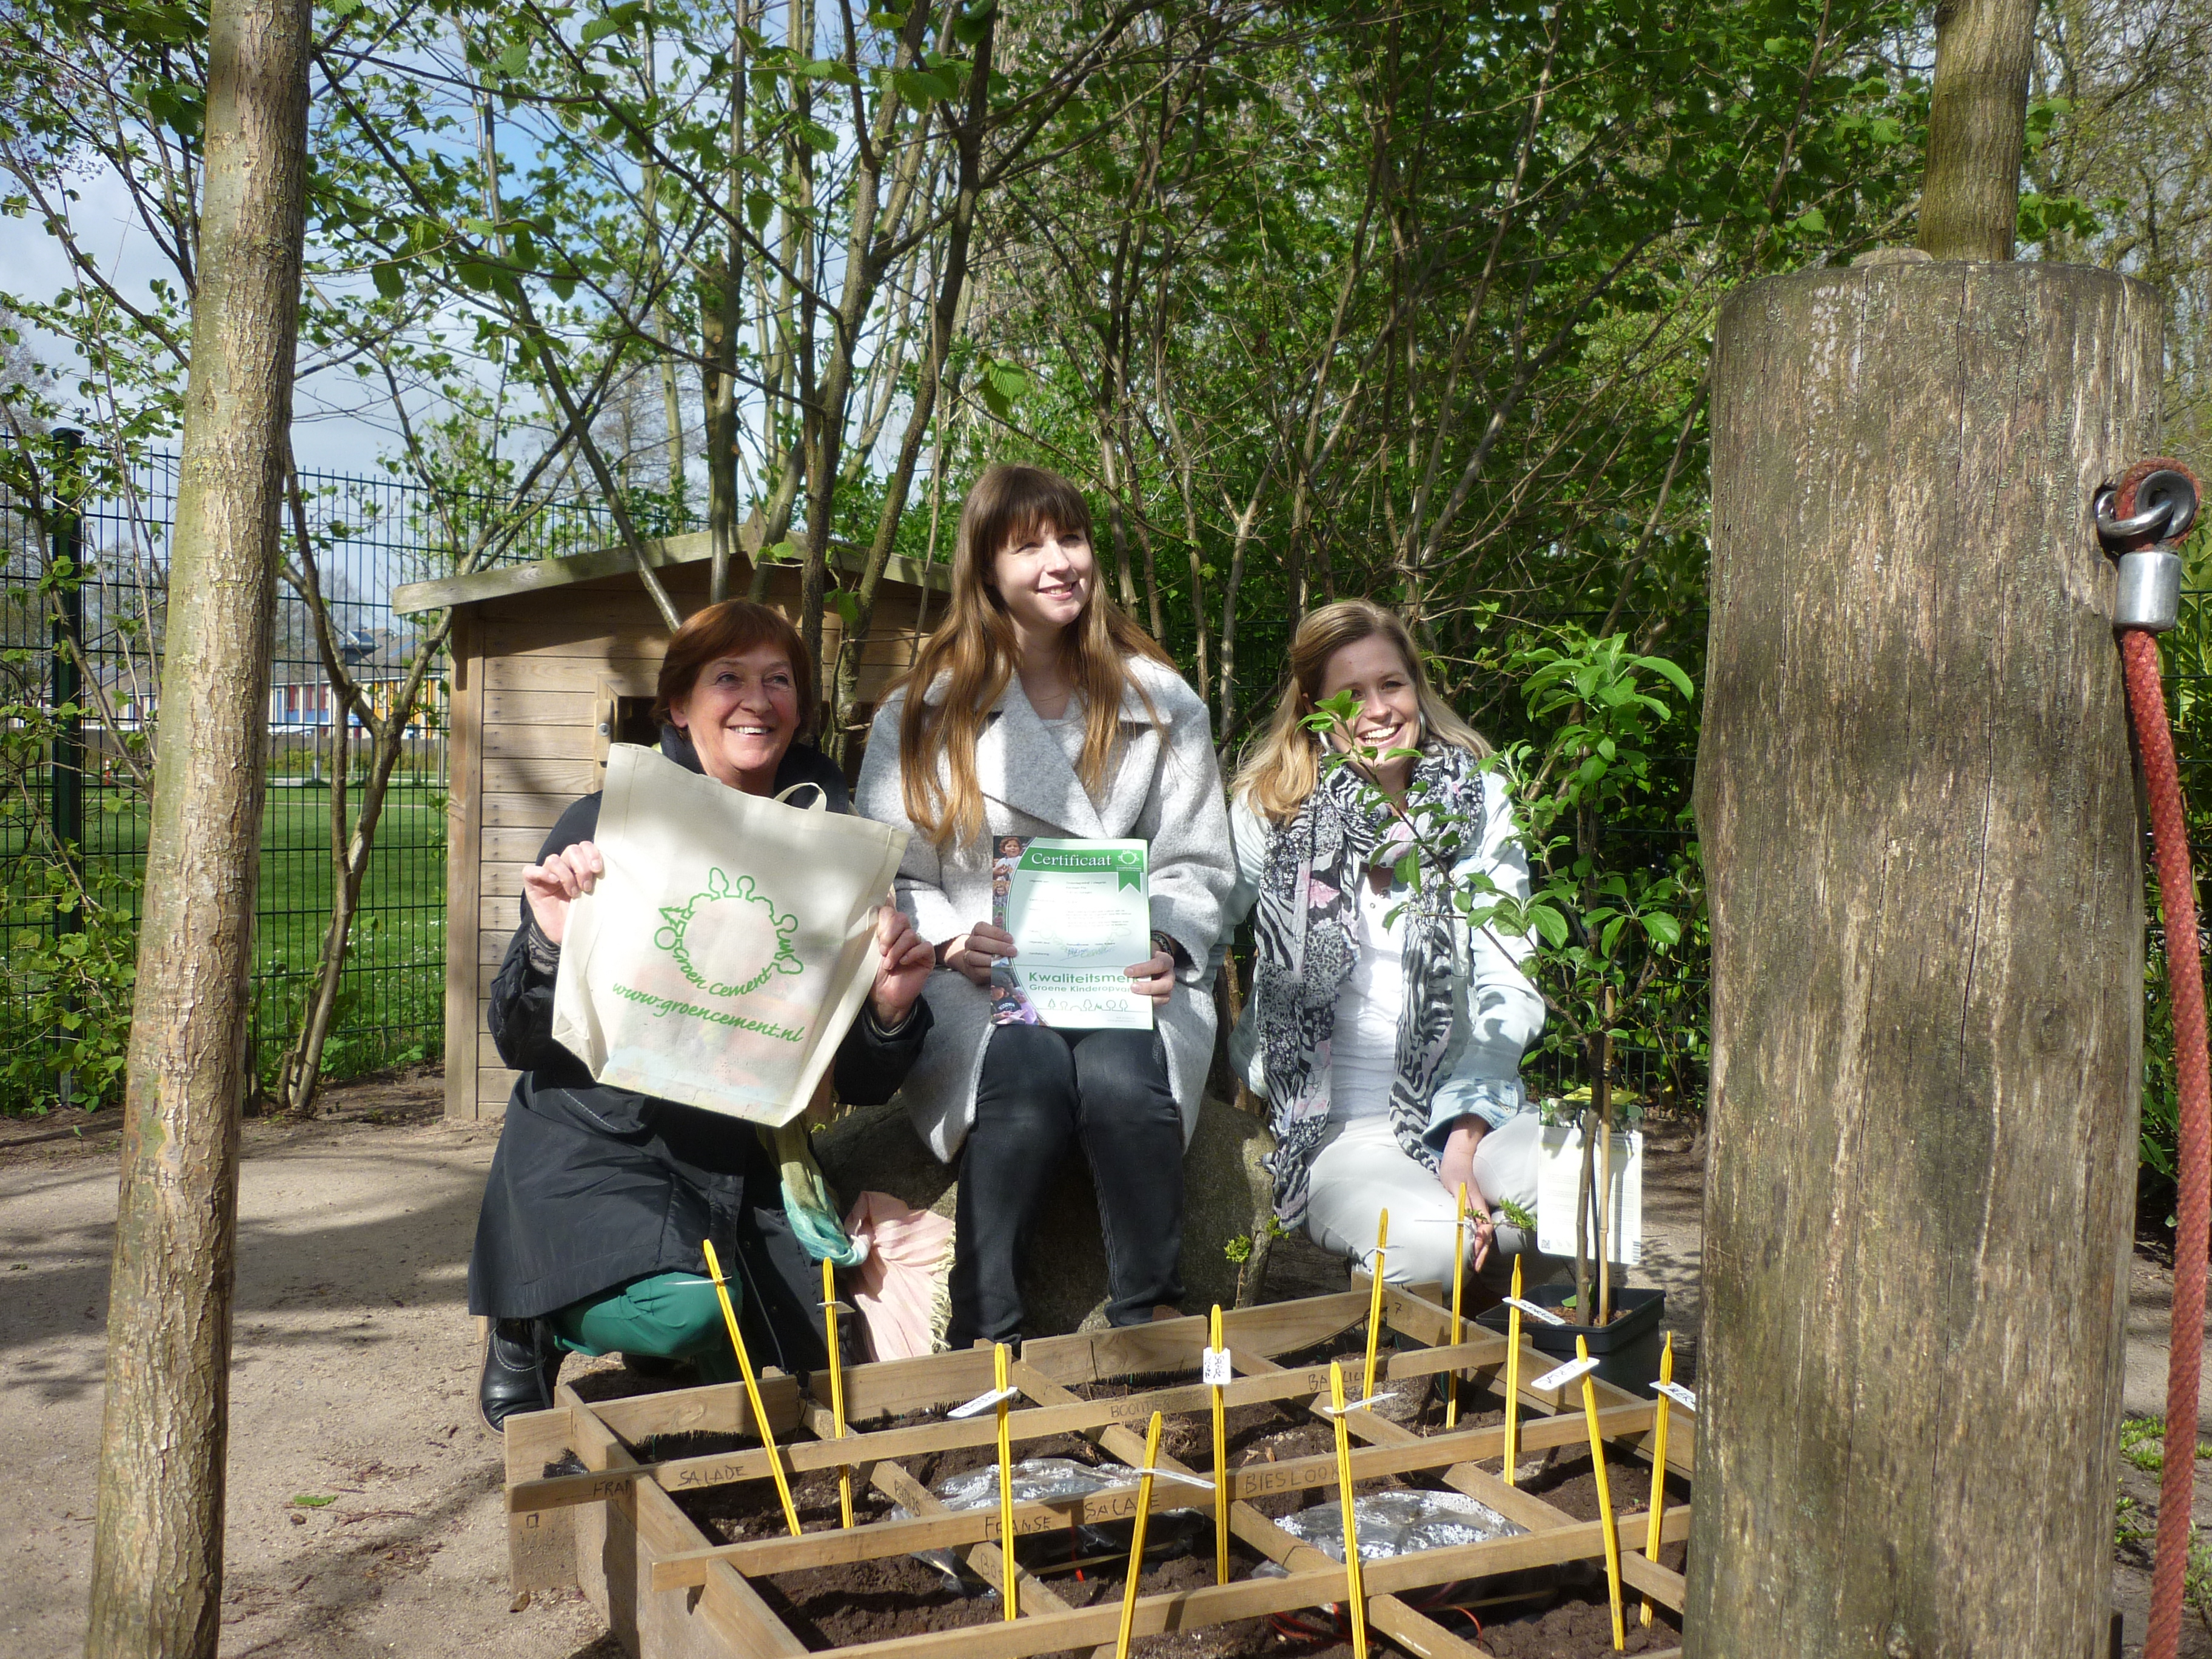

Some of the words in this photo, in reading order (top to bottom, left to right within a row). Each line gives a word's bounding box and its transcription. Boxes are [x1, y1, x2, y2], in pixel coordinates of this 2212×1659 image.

[1031, 853, 1113, 867] Certificaat
[672, 947, 708, 990] Groen
[708, 967, 773, 997] Cement
[1029, 984, 1067, 992] Groene
[612, 982, 805, 1042] www.groencement.nl
[677, 1464, 749, 1487] SALADE
[1084, 1493, 1159, 1521] SALAE
